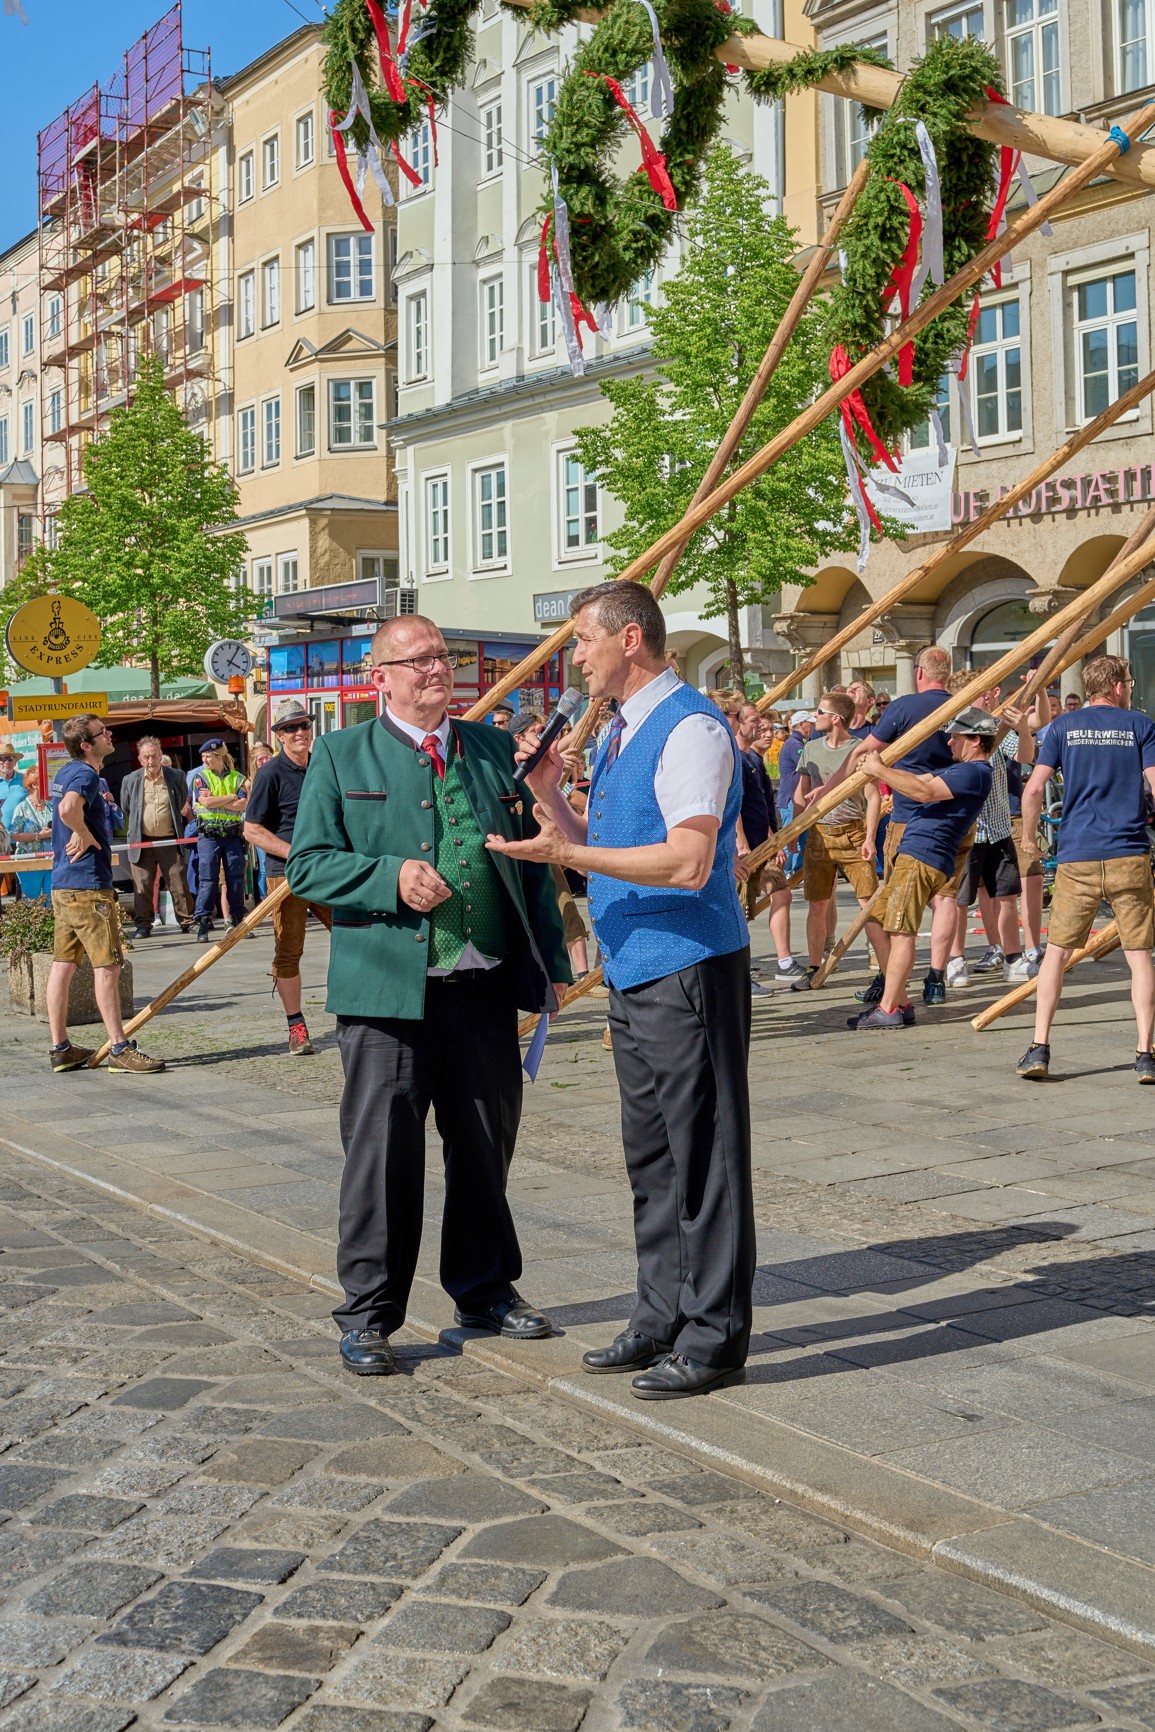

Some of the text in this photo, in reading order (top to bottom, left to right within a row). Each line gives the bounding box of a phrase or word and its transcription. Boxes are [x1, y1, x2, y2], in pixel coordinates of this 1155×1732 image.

[893, 471, 944, 489] MIETEN
[998, 463, 1155, 516] HOFSTÆTT
[535, 598, 565, 618] dean
[29, 643, 84, 665] EXPRESS
[18, 700, 103, 713] STADTRUNDFAHRT
[1066, 729, 1134, 740] FEUERWEHR
[1067, 738, 1134, 747] NIEDERWALDKIRCHEN
